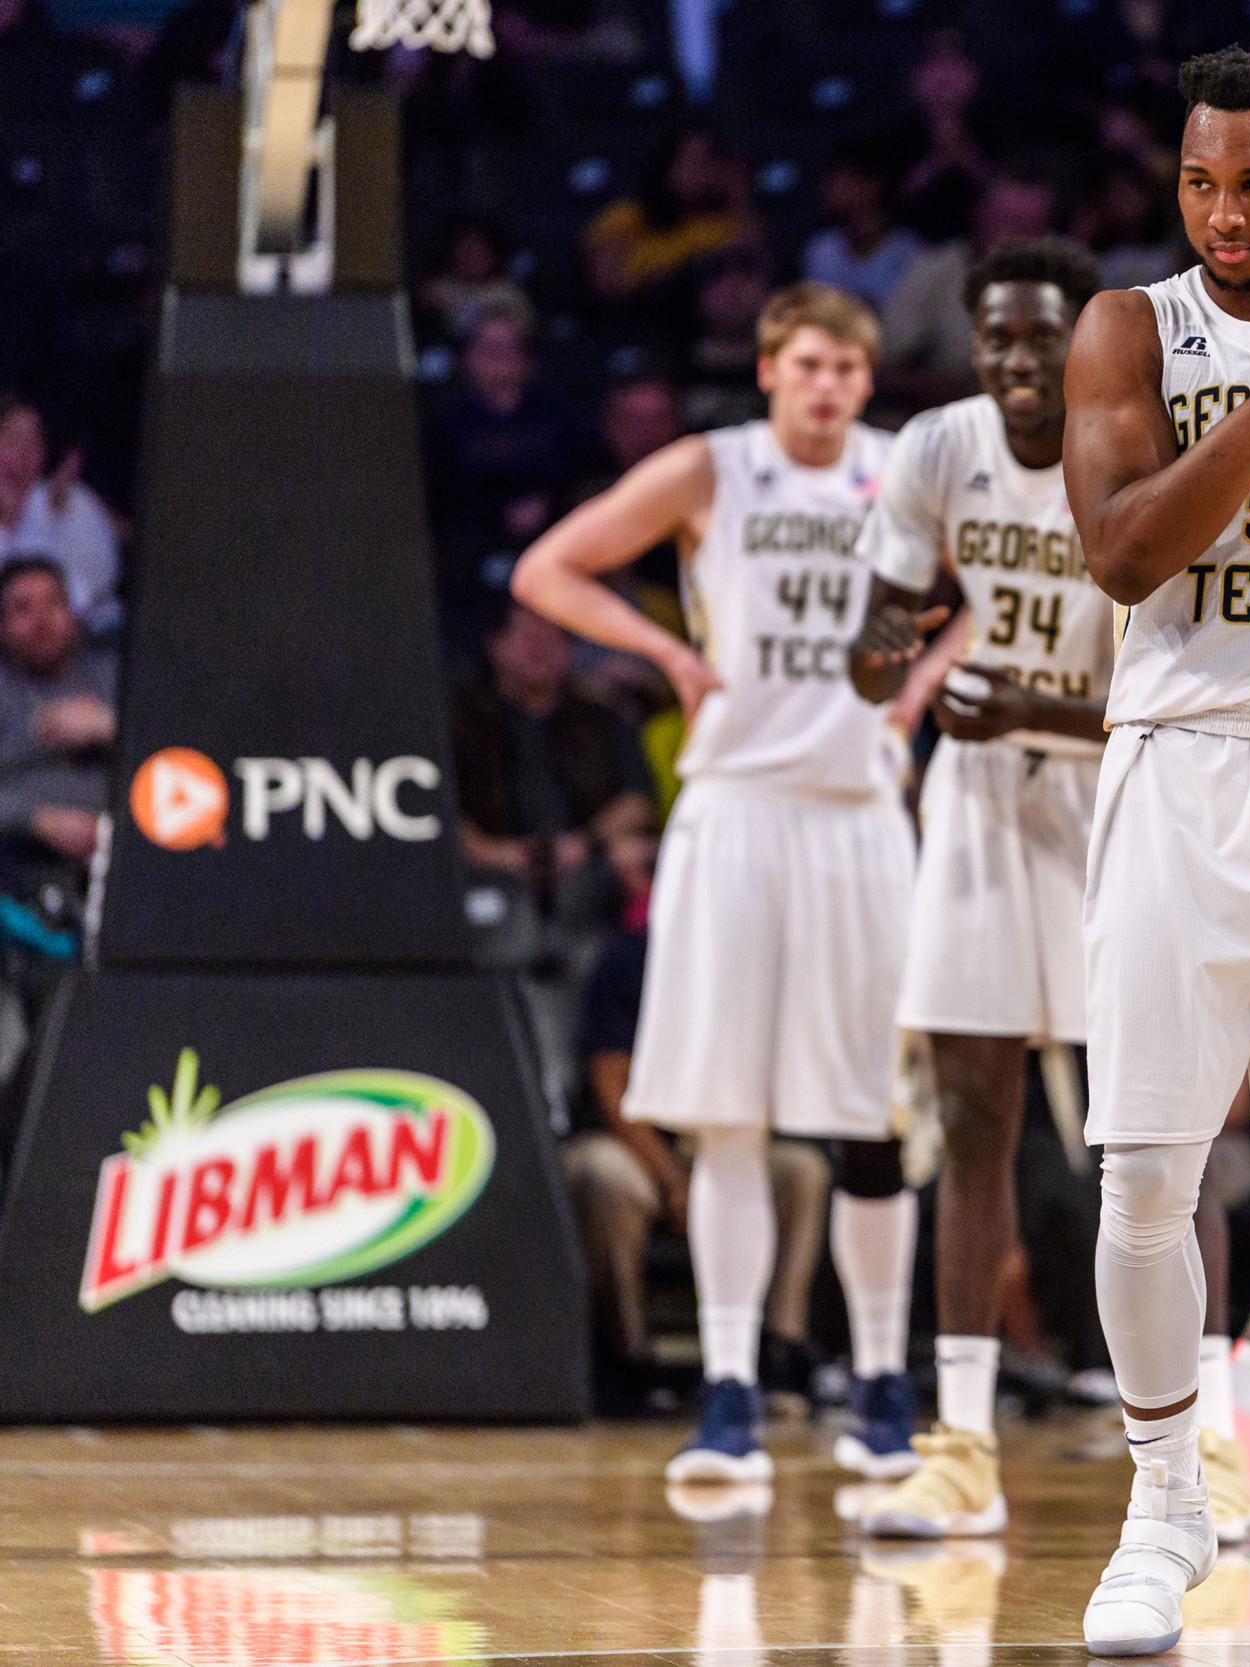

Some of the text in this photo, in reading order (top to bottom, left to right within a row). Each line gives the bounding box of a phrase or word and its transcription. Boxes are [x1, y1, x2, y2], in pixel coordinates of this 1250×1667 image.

[778, 568, 852, 626] 44
[988, 583, 1063, 655] 34
[756, 633, 848, 681] TEC
[232, 754, 442, 841] PNC
[97, 1108, 450, 1290] LIBMAN
